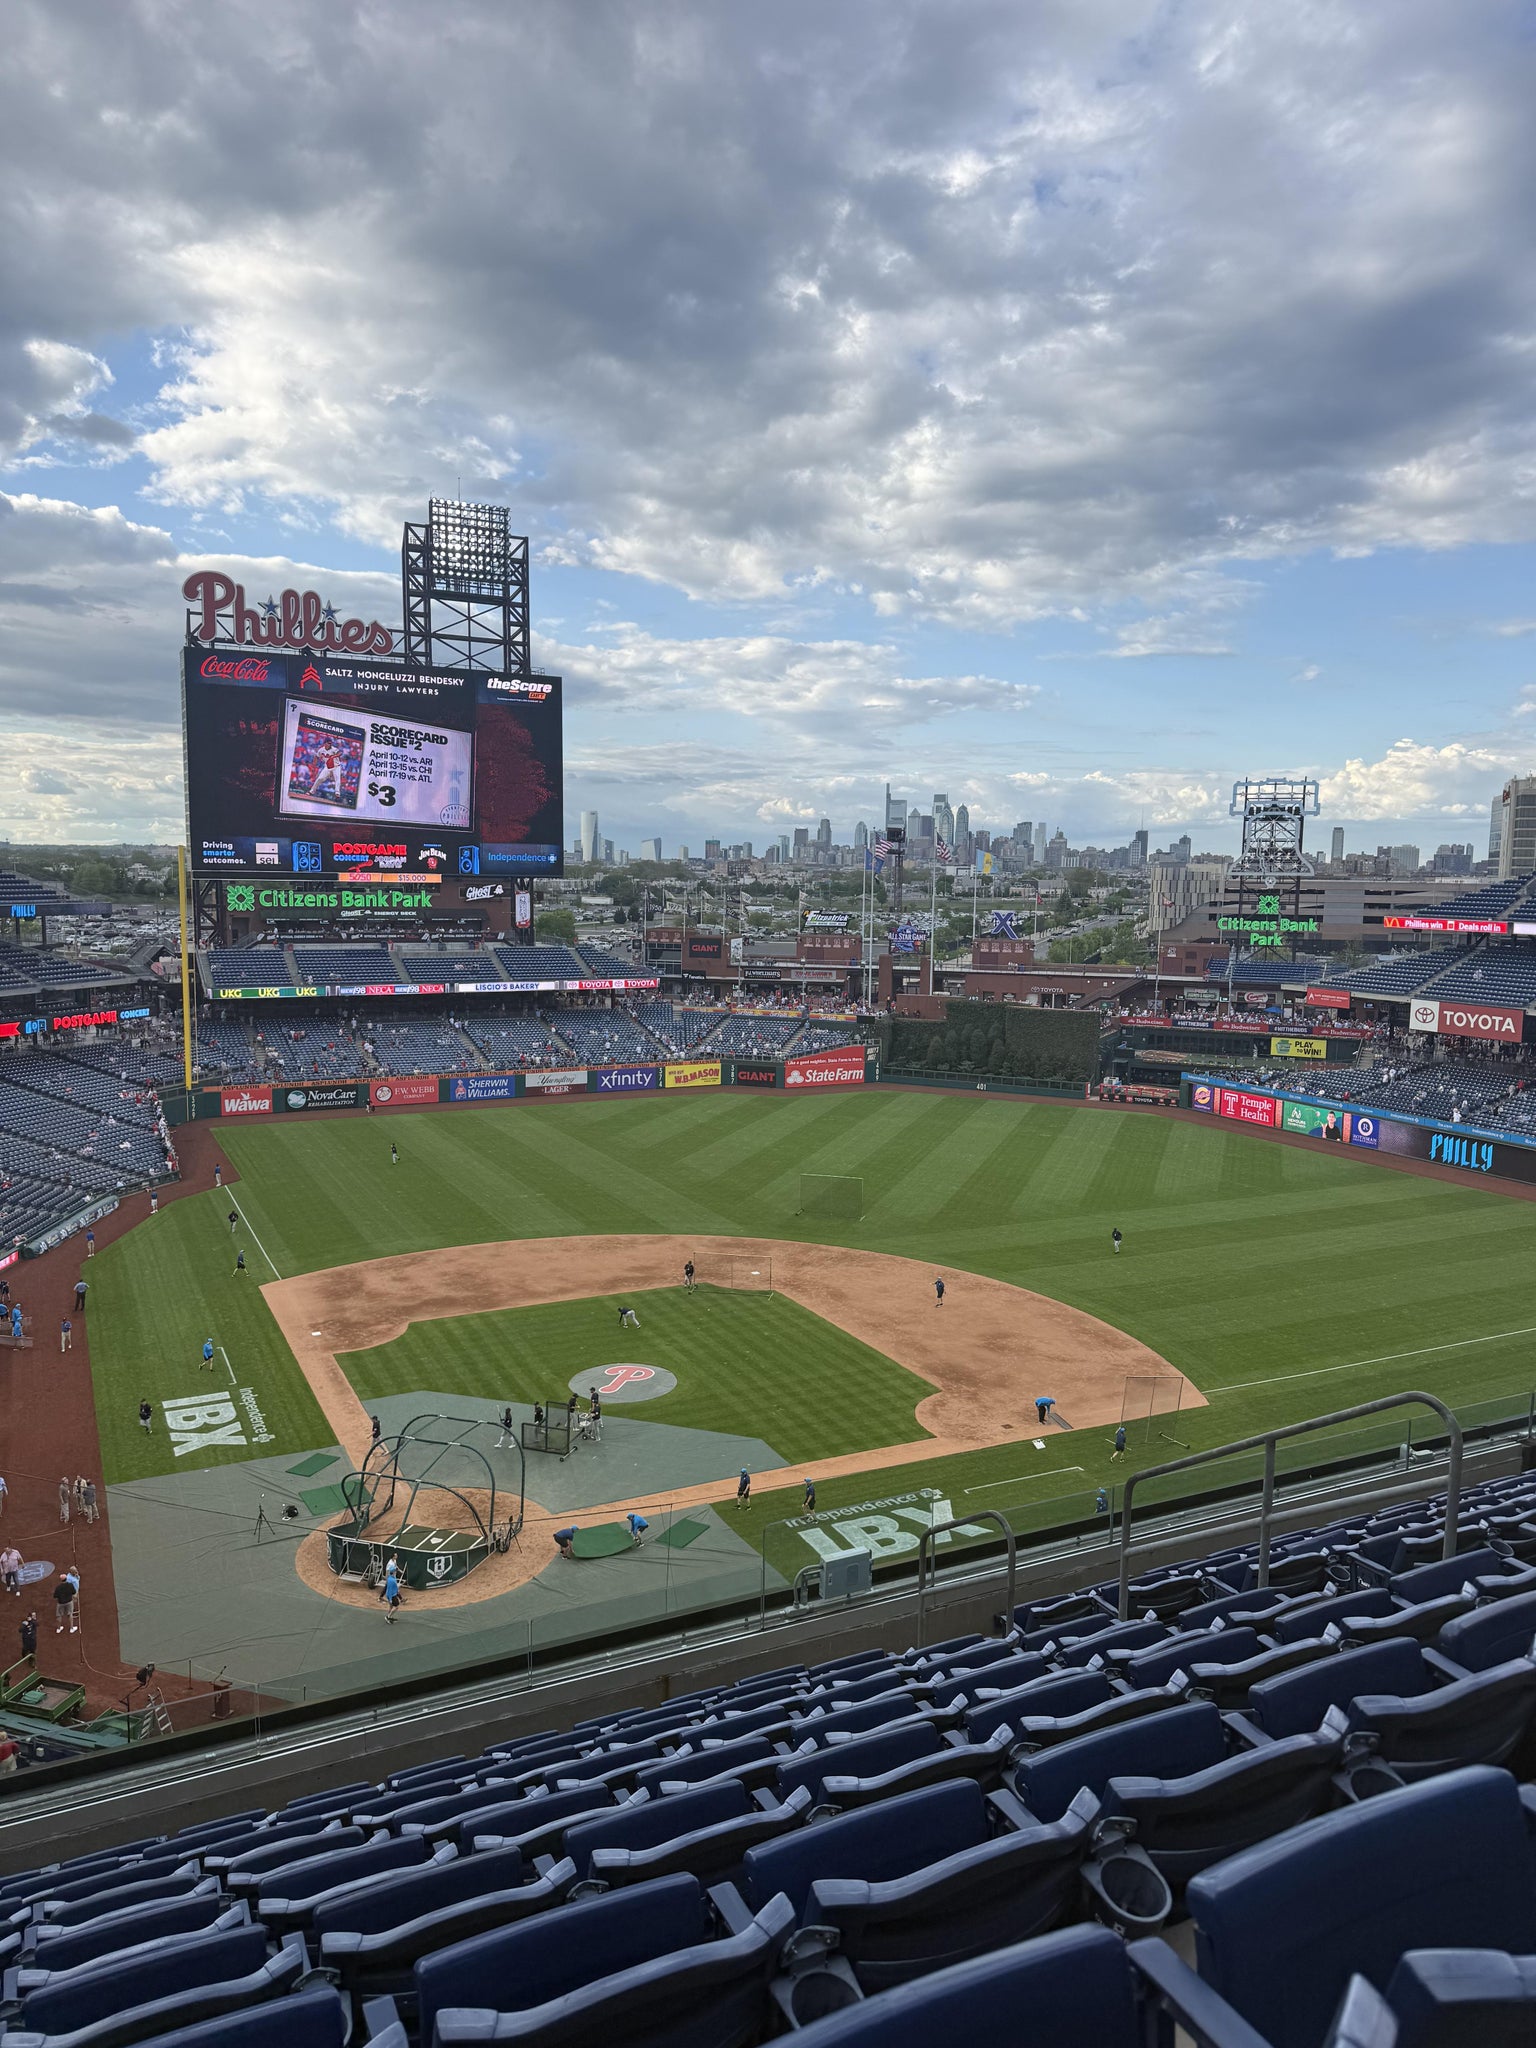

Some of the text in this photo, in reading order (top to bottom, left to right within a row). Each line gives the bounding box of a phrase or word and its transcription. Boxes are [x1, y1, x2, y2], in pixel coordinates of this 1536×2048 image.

[183, 571, 393, 655] Phillies
[200, 655, 272, 681] Coca-Cola
[325, 668, 464, 686] SALTZ MONGELUZZI BENDESKY
[353, 683, 439, 695] INJURY LAWYERS
[487, 678, 552, 693] theScore
[306, 720, 344, 733] SCORECARD
[370, 723, 448, 745] SCORECARD
[371, 734, 422, 751] ISSUE #2
[369, 750, 388, 759] April
[389, 753, 408, 763] 10-12
[420, 758, 433, 766] ARI
[369, 759, 387, 768] April
[389, 762, 407, 771] 13-15
[419, 766, 432, 774] CHI
[368, 768, 387, 777] April
[389, 771, 406, 780] 17-19
[418, 775, 432, 783] ATL
[368, 782, 396, 807] $3
[203, 842, 233, 850] Driving
[333, 843, 407, 855] POSTGAME
[488, 852, 546, 862] Independence
[259, 890, 432, 907] Citizens Bank Park
[466, 885, 496, 901] GHOST
[11, 905, 36, 917] PHILLY
[808, 911, 849, 921] Fitzpatrick
[1217, 917, 1318, 931] Citizens Bank
[1405, 920, 1430, 929] Phillies
[1430, 921, 1443, 929] win
[1459, 922, 1479, 931] Deals
[1480, 923, 1492, 931] roll
[899, 932, 912, 940] STAR
[1250, 933, 1283, 945] Park
[220, 987, 317, 997] UKG UKG UKG
[369, 986, 391, 994] NECA
[421, 985, 444, 993] NECA
[475, 983, 507, 991] LISCIO'S
[53, 1008, 150, 1030] POSTGAME CONCERT
[1443, 1010, 1516, 1034] TOYOTA
[468, 1079, 508, 1088] SHERWIN
[537, 1074, 576, 1085] Yuengling
[601, 1071, 652, 1088] xfinity
[738, 1072, 775, 1081] GIANT
[308, 1089, 356, 1101] NovaCare
[410, 1086, 435, 1094] WEBB
[467, 1088, 508, 1098] WILLIAMS
[224, 1099, 271, 1112] Wawa
[1240, 1096, 1272, 1110] Temple
[1240, 1108, 1270, 1122] Health
[1472, 1128, 1500, 1138] Independence
[1429, 1133, 1493, 1172] PHILLY
[599, 1364, 655, 1394] P
[239, 1387, 267, 1433] Independence
[161, 1391, 248, 1457] IBX
[785, 1492, 917, 1529] Independence
[797, 1499, 994, 1560] IBX
